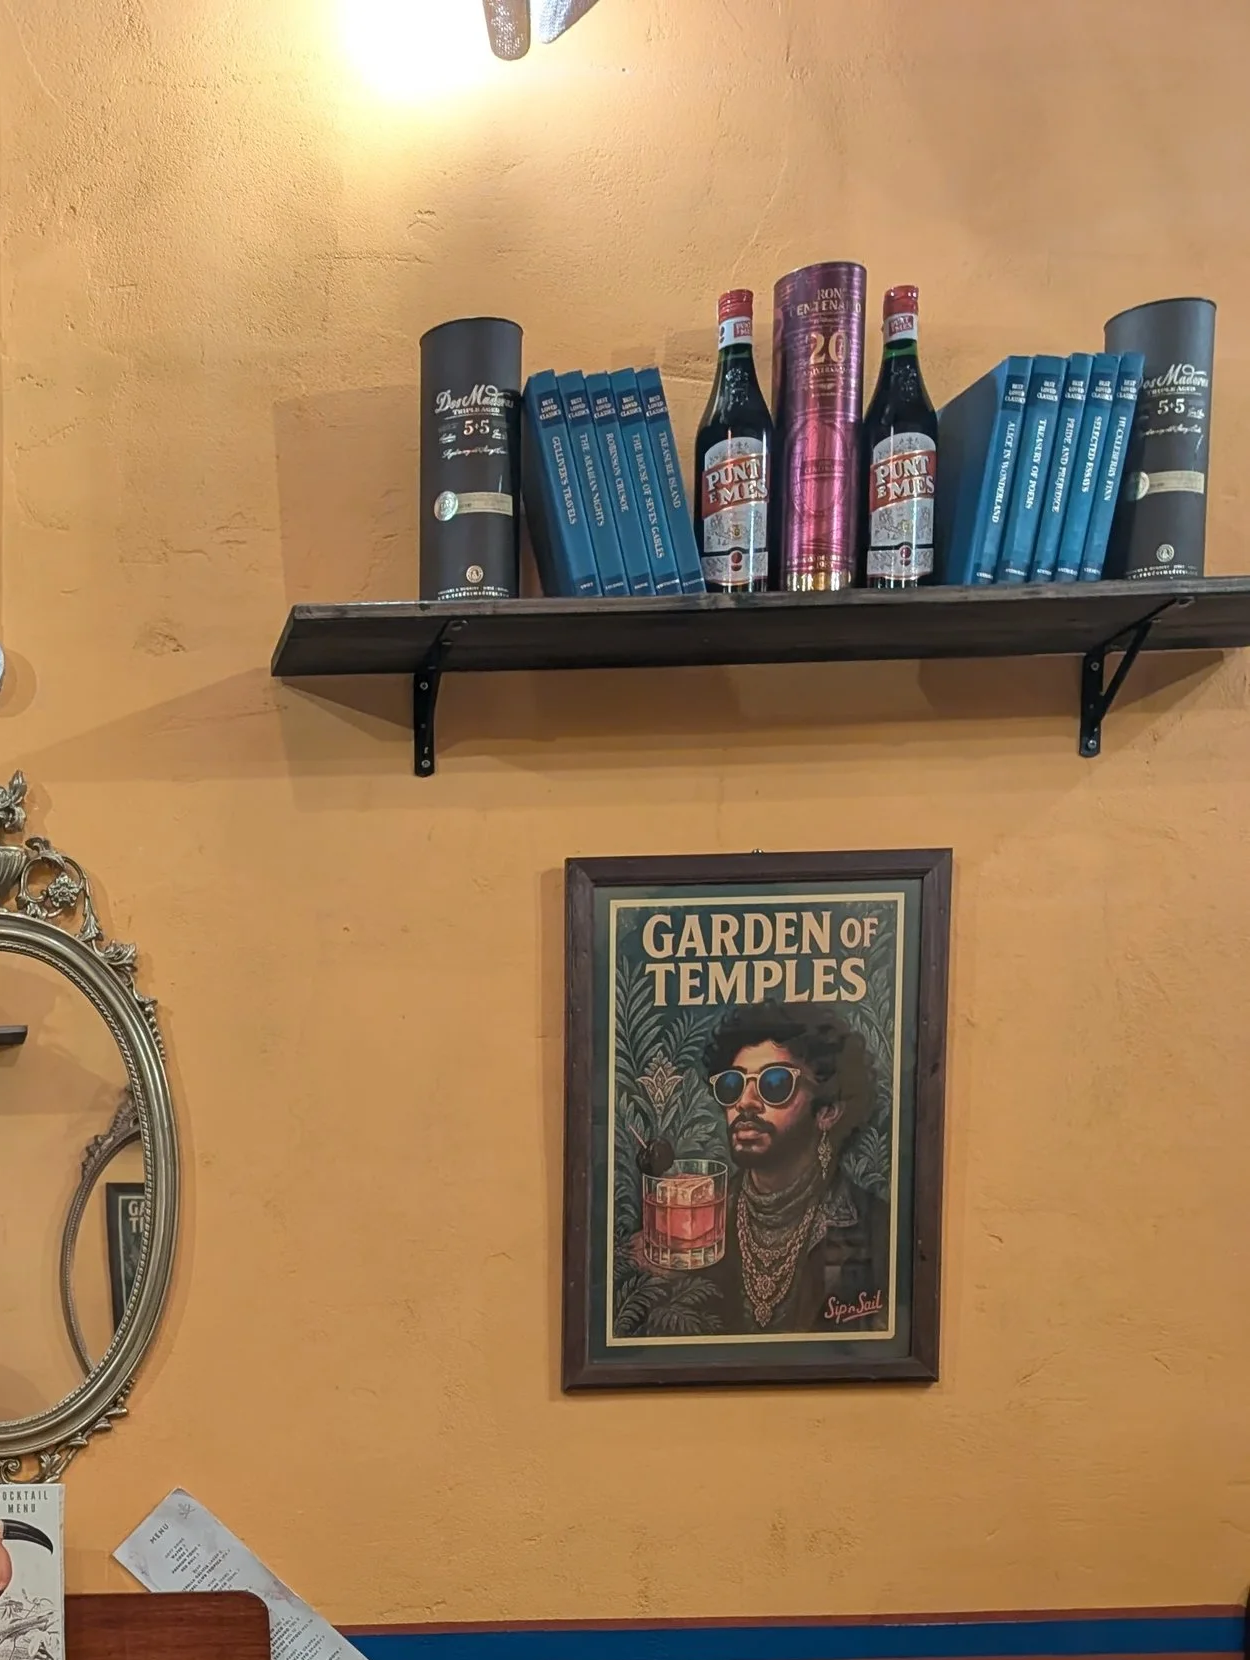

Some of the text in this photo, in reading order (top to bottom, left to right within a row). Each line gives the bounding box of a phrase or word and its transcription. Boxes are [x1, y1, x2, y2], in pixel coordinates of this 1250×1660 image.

[789, 300, 861, 316] ENTENAO
[810, 331, 847, 364] 20
[435, 389, 462, 414] Dos
[1157, 398, 1185, 415] 5+5
[463, 419, 490, 436] 5+5
[605, 432, 629, 513] ROBINSON CRUSOE
[658, 431, 681, 509] TREASURE ISLAND
[875, 455, 929, 486] PUNT
[992, 420, 1016, 523] ALICE IN WONDERLAND
[1025, 418, 1048, 510] TREASURY OF POEMS
[1052, 417, 1076, 513] PRIDE AND PREJUDICE
[1081, 415, 1103, 493] SELECTED ESSAYS
[1104, 416, 1127, 502] HUCKLEBERRY FINN
[579, 432, 605, 528] THE ARABIAN NIGHTS
[706, 459, 761, 492] PUNT
[877, 475, 935, 501] E MES
[563, 486, 577, 525] TRAVELS
[632, 432, 665, 559] THE HOUSE OF SEVEN GABLES
[708, 480, 768, 510] E MES
[642, 910, 878, 959] GARDEN OF
[645, 957, 867, 1006] TEMPLES
[824, 1296, 847, 1324] Sip
[856, 1289, 883, 1314] Sail
[7, 1503, 37, 1514] MENU
[149, 1522, 169, 1544] MENU
